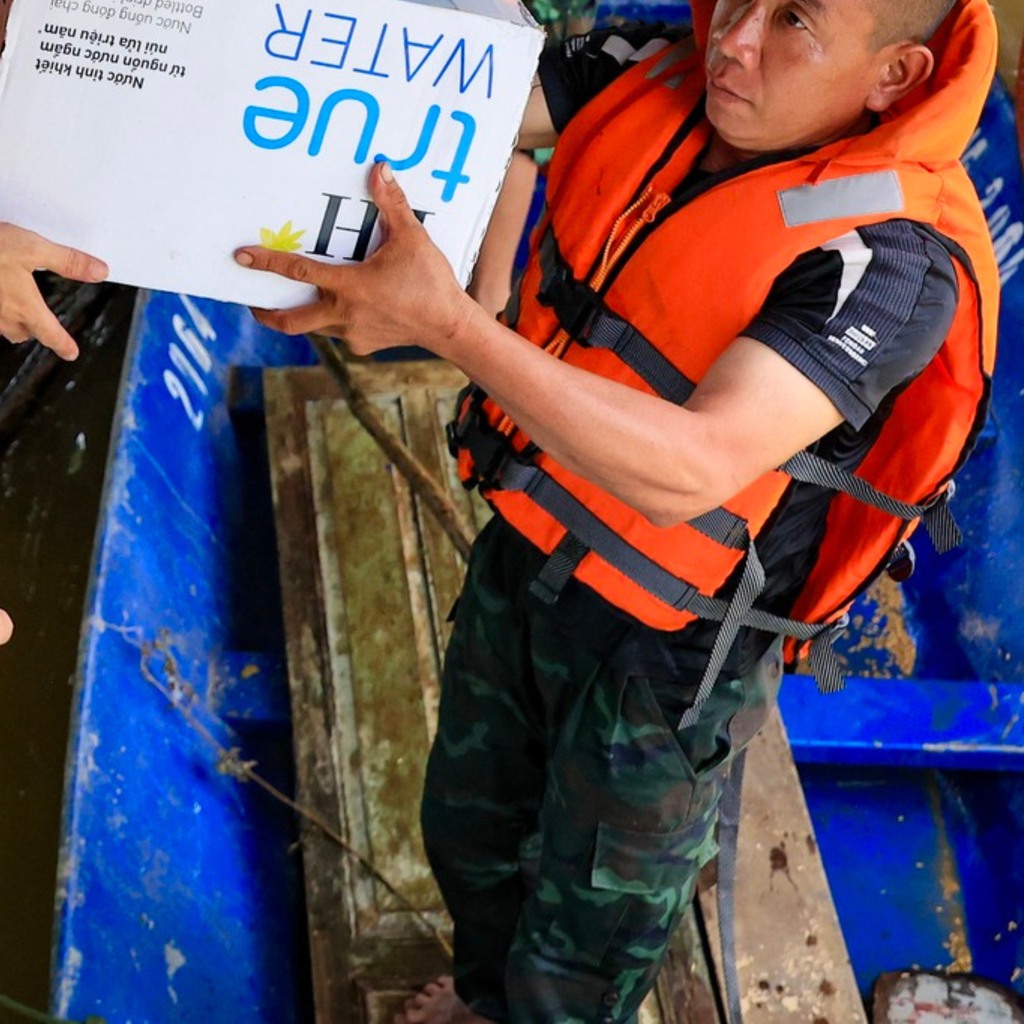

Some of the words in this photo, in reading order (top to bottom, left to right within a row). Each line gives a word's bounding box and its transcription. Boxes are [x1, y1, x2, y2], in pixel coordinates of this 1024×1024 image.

[82, 0, 116, 20] đóng
[118, 7, 153, 26] uống
[155, 15, 192, 34] Nước
[79, 29, 115, 46] triệu
[118, 37, 142, 53] lửa
[39, 41, 81, 59] ngầm
[84, 48, 120, 64] nước
[145, 42, 168, 56] núi
[264, 3, 494, 99] WATER
[34, 58, 72, 77] khiết
[75, 65, 105, 81] tinh
[123, 56, 168, 74] nguồn
[169, 65, 186, 78] từ
[107, 71, 145, 89] Nước
[243, 76, 476, 203] true
[304, 193, 435, 262] H
